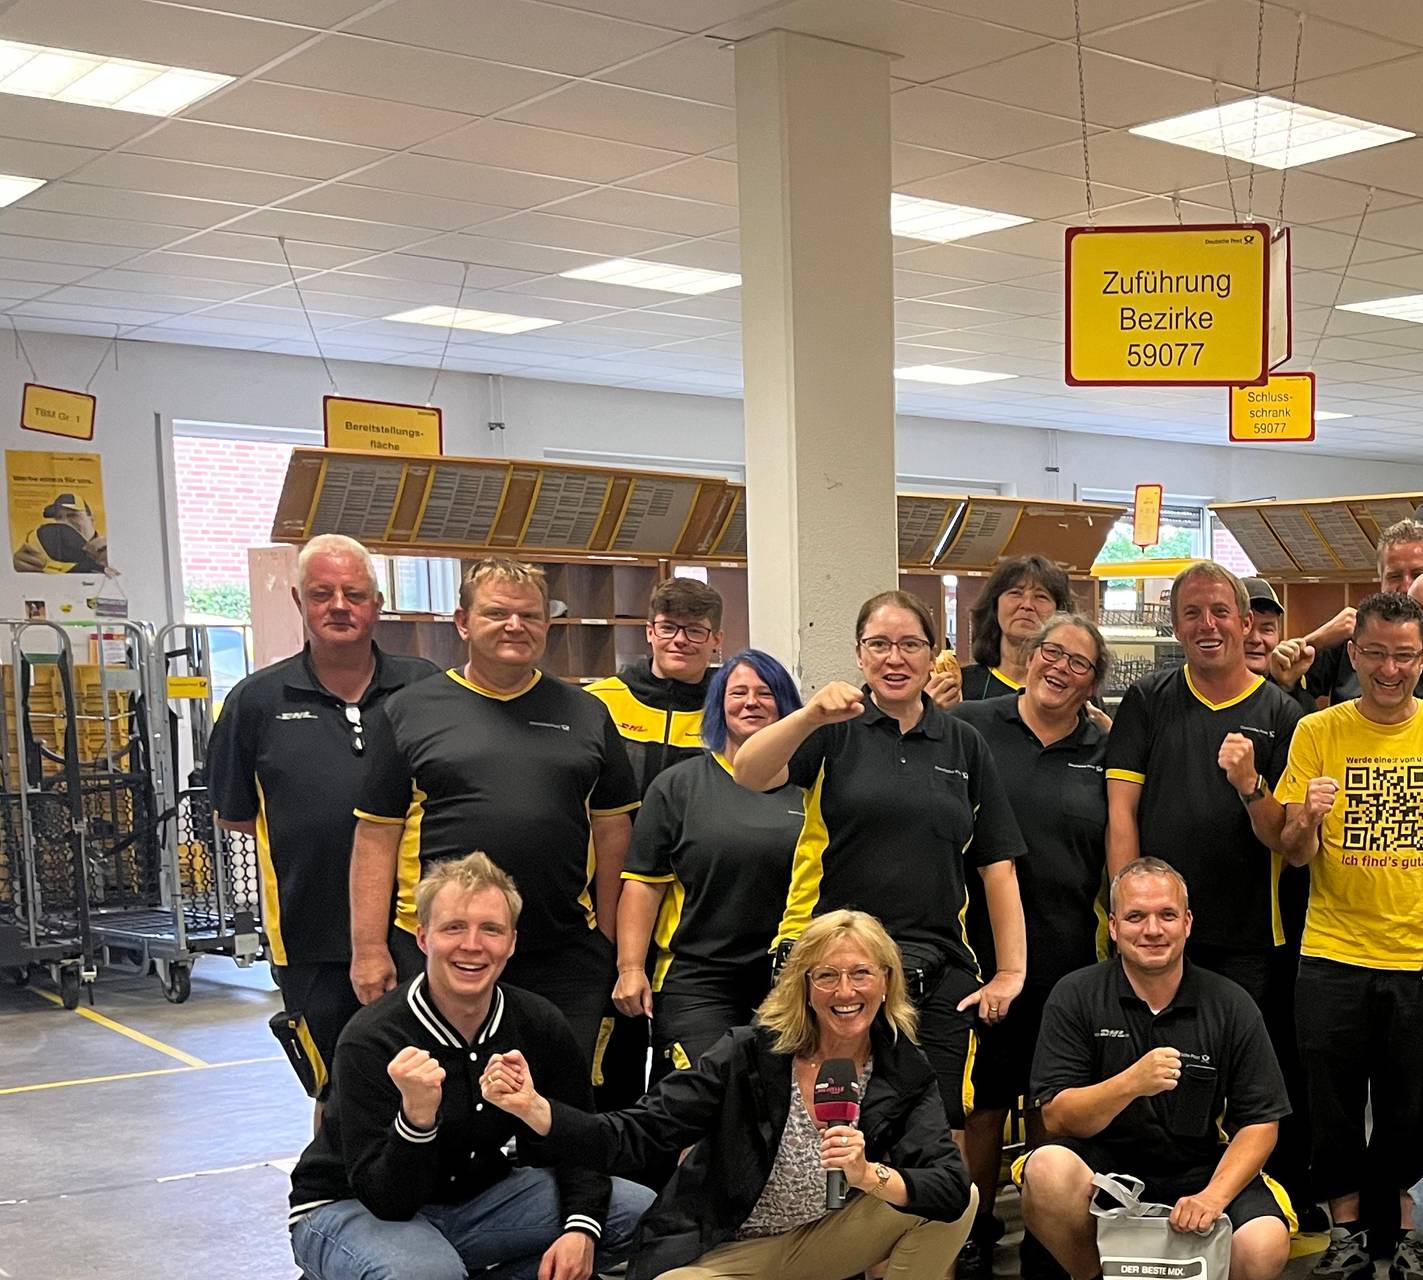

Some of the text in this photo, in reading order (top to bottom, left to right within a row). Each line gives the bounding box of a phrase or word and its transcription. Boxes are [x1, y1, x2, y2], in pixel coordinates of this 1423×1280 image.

[1102, 270, 1232, 298] Zuführung
[1119, 306, 1214, 331] Bezirke
[1126, 343, 1205, 367] 59077
[1247, 391, 1294, 403] Schluss-
[1249, 407, 1291, 418] schrank
[345, 421, 424, 438] Bereitstellungs-
[1253, 422, 1287, 434] 59077
[1345, 756, 1373, 764] Werde
[1399, 756, 1416, 764] von
[1342, 854, 1359, 867] Ich
[1361, 854, 1398, 868] find's
[1120, 1265, 1140, 1274] DER
[1141, 1265, 1167, 1275] BESTE
